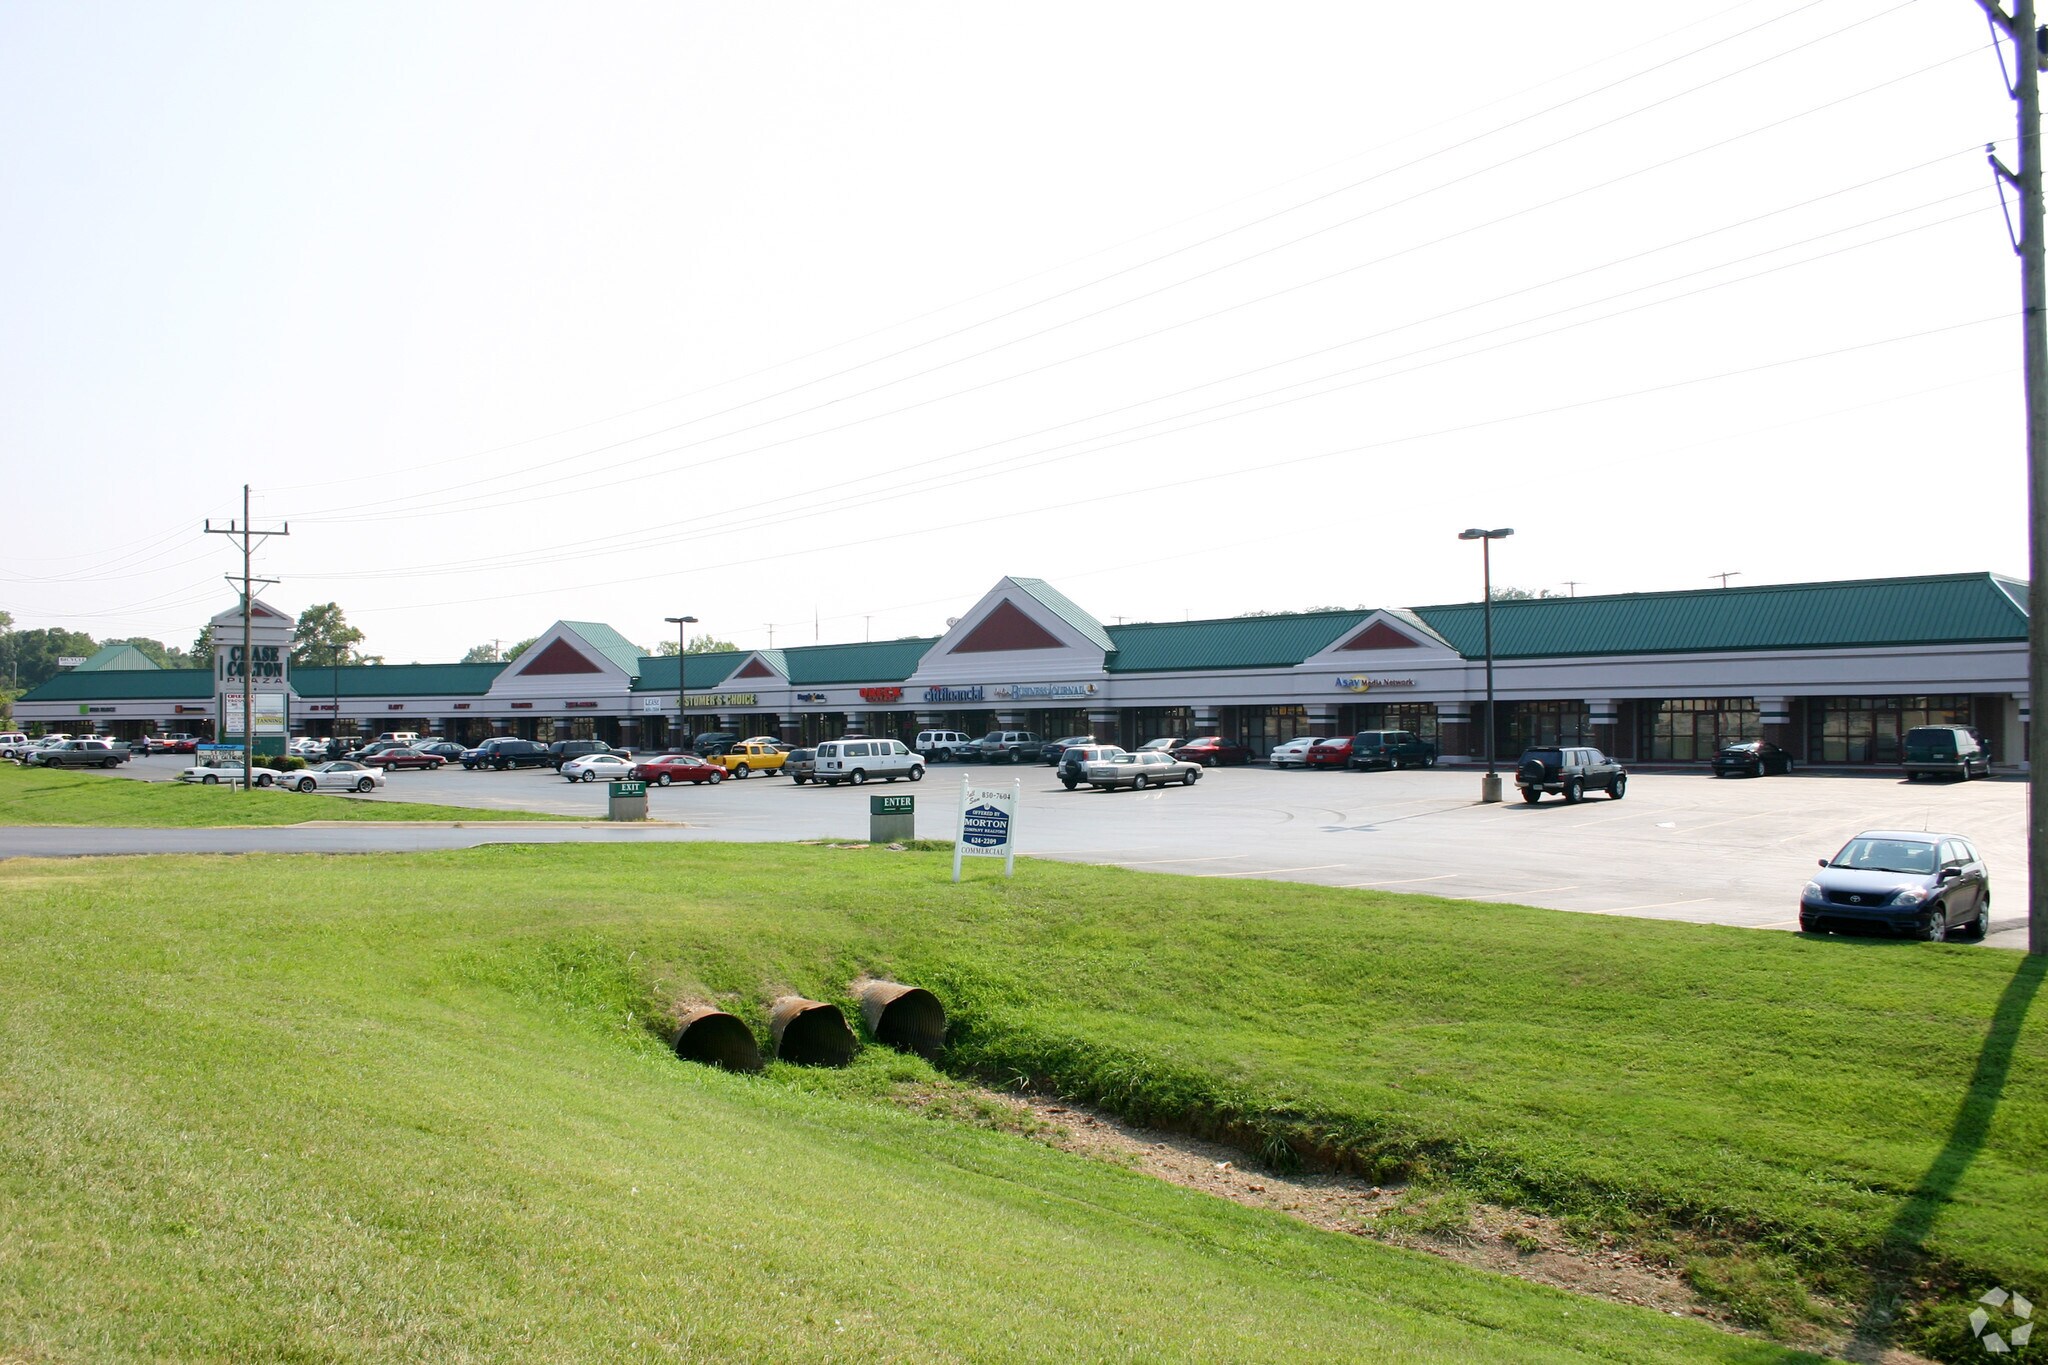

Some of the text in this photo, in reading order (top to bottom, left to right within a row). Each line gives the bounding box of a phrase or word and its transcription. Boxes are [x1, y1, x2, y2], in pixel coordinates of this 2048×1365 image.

[227, 661, 284, 678] COTON
[1335, 677, 1360, 690] Asay
[1361, 679, 1383, 688] Media
[675, 693, 757, 707] CSTOMER'S CHOICE
[621, 783, 640, 791] EXIT
[884, 797, 912, 807] ENTER
[964, 818, 1008, 829] MORTON
[961, 846, 1005, 856] COMMERCIAL
